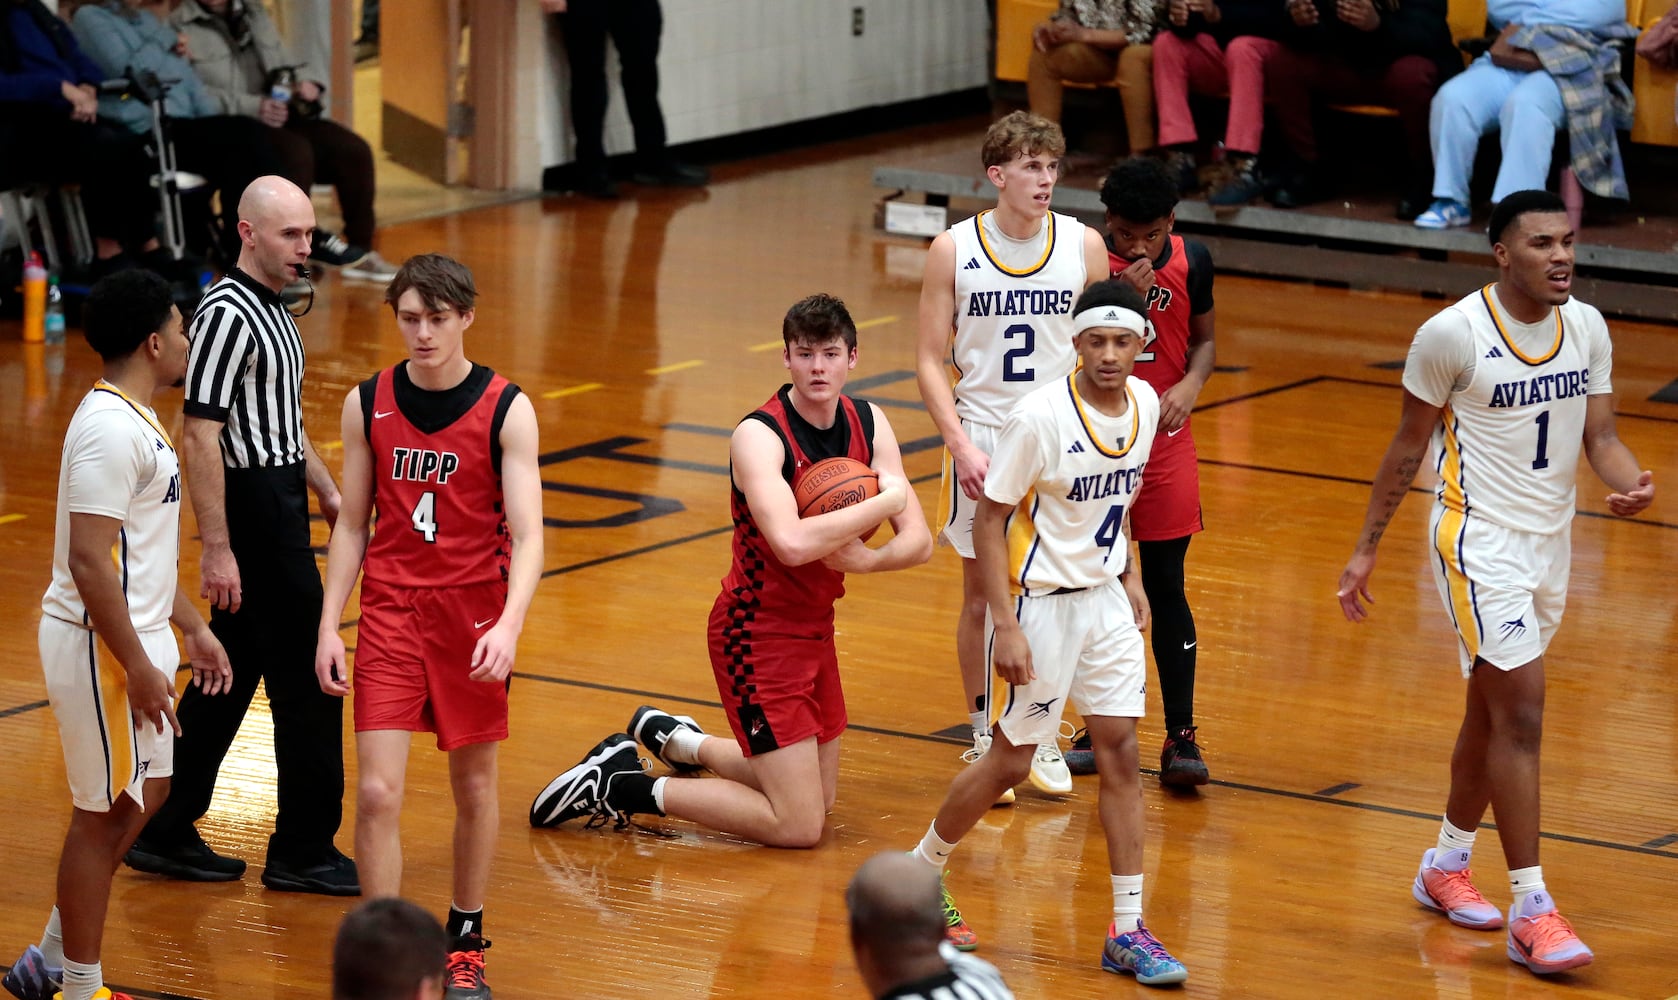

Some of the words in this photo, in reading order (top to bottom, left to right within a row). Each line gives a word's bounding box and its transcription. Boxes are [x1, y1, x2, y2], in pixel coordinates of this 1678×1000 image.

[967, 289, 1073, 317] AVIATORS
[1145, 284, 1173, 311] PP
[1003, 323, 1035, 382] 2
[1488, 368, 1589, 408] AVIATORS
[1532, 410, 1550, 470] 1
[392, 446, 460, 485] TIPP
[1066, 463, 1145, 502] AVIATO
[411, 491, 438, 544] 4
[1094, 504, 1125, 565] 4
